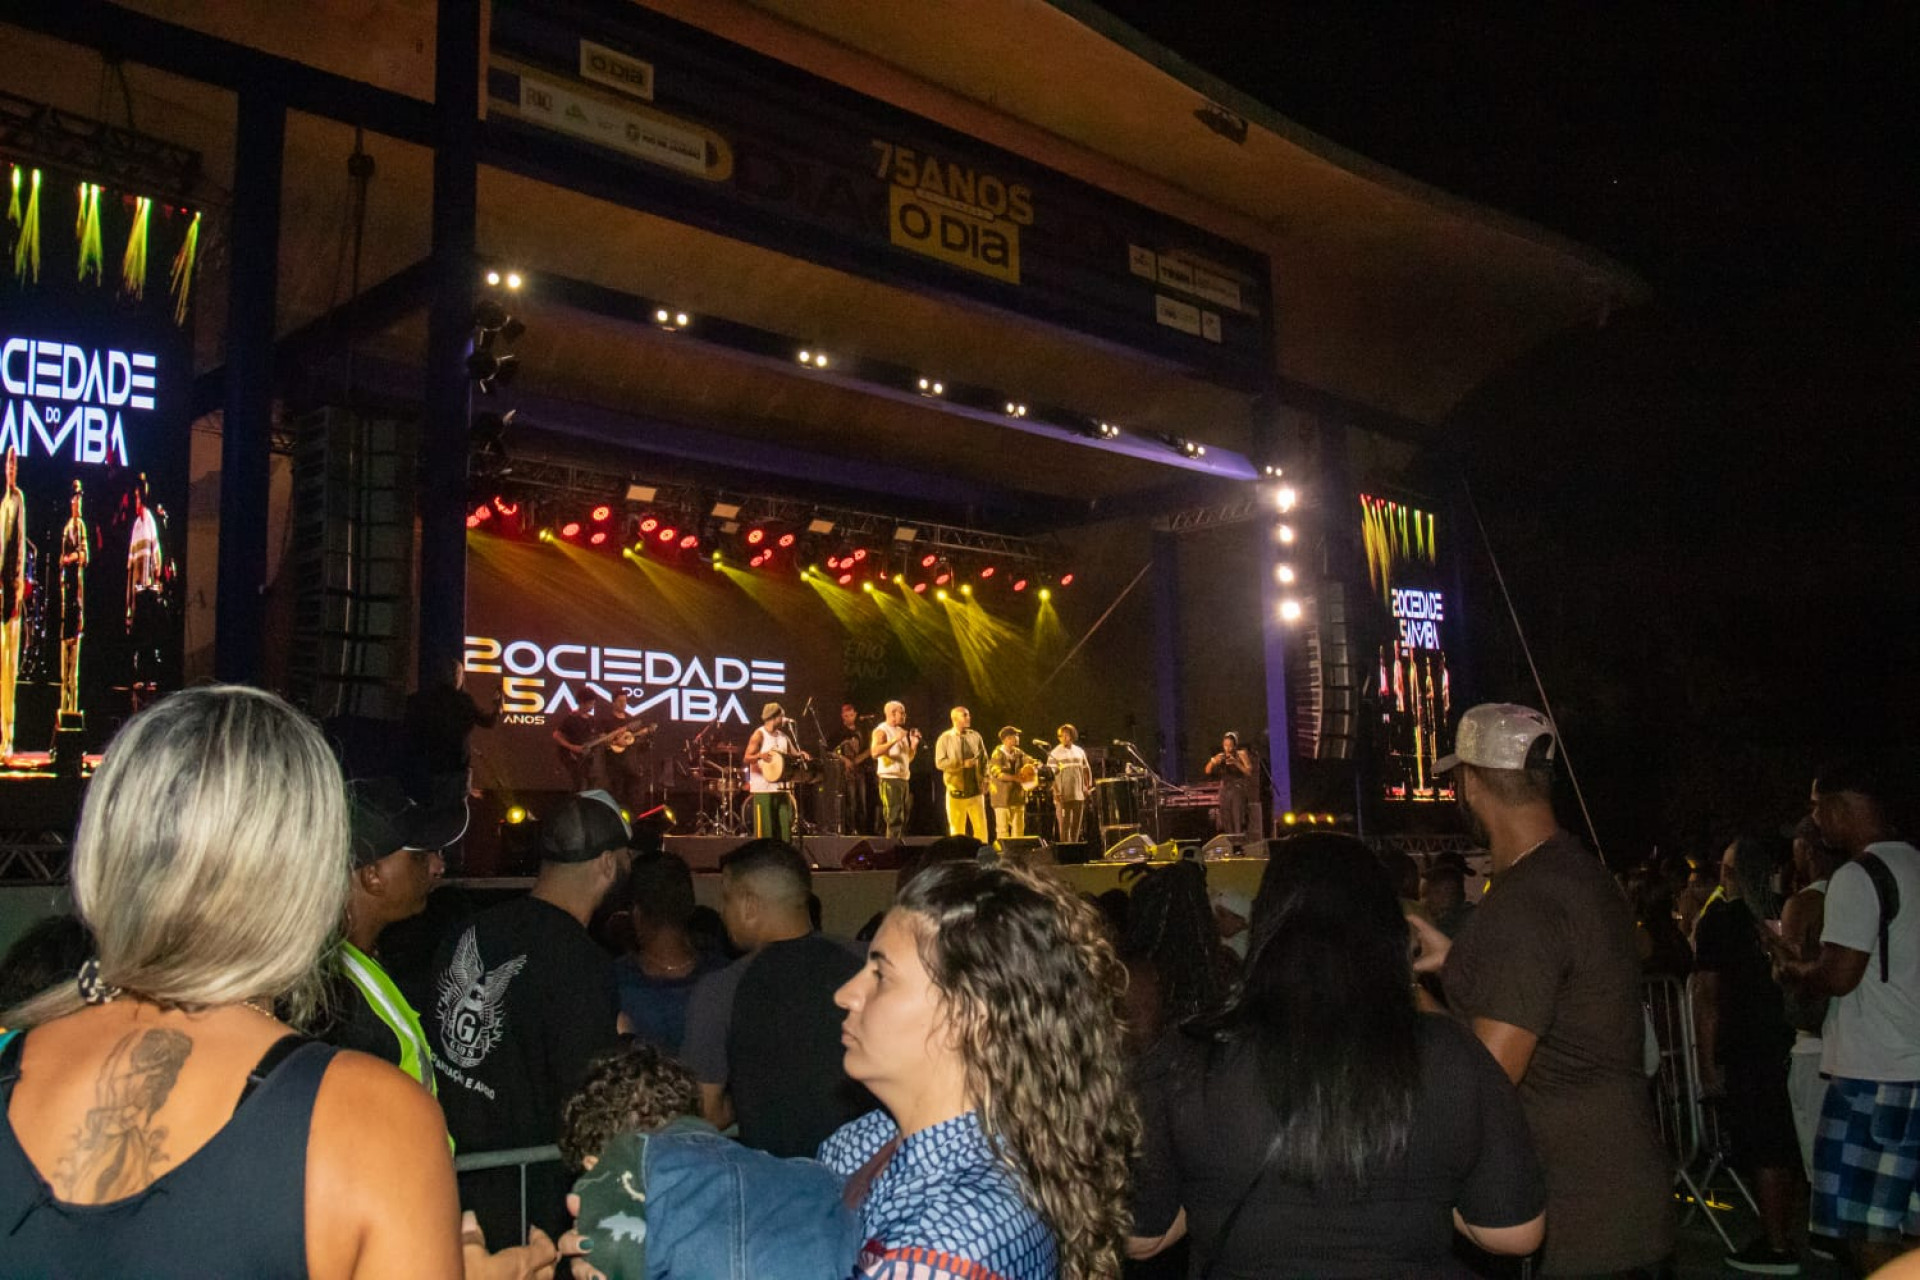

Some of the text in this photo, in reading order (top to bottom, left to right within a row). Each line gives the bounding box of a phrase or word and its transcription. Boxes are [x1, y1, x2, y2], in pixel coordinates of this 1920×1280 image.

[900, 203, 931, 240] O
[0, 338, 156, 410] CIEDADE
[46, 407, 61, 423] DO
[503, 715, 545, 725] ANOS
[457, 1013, 476, 1043] G
